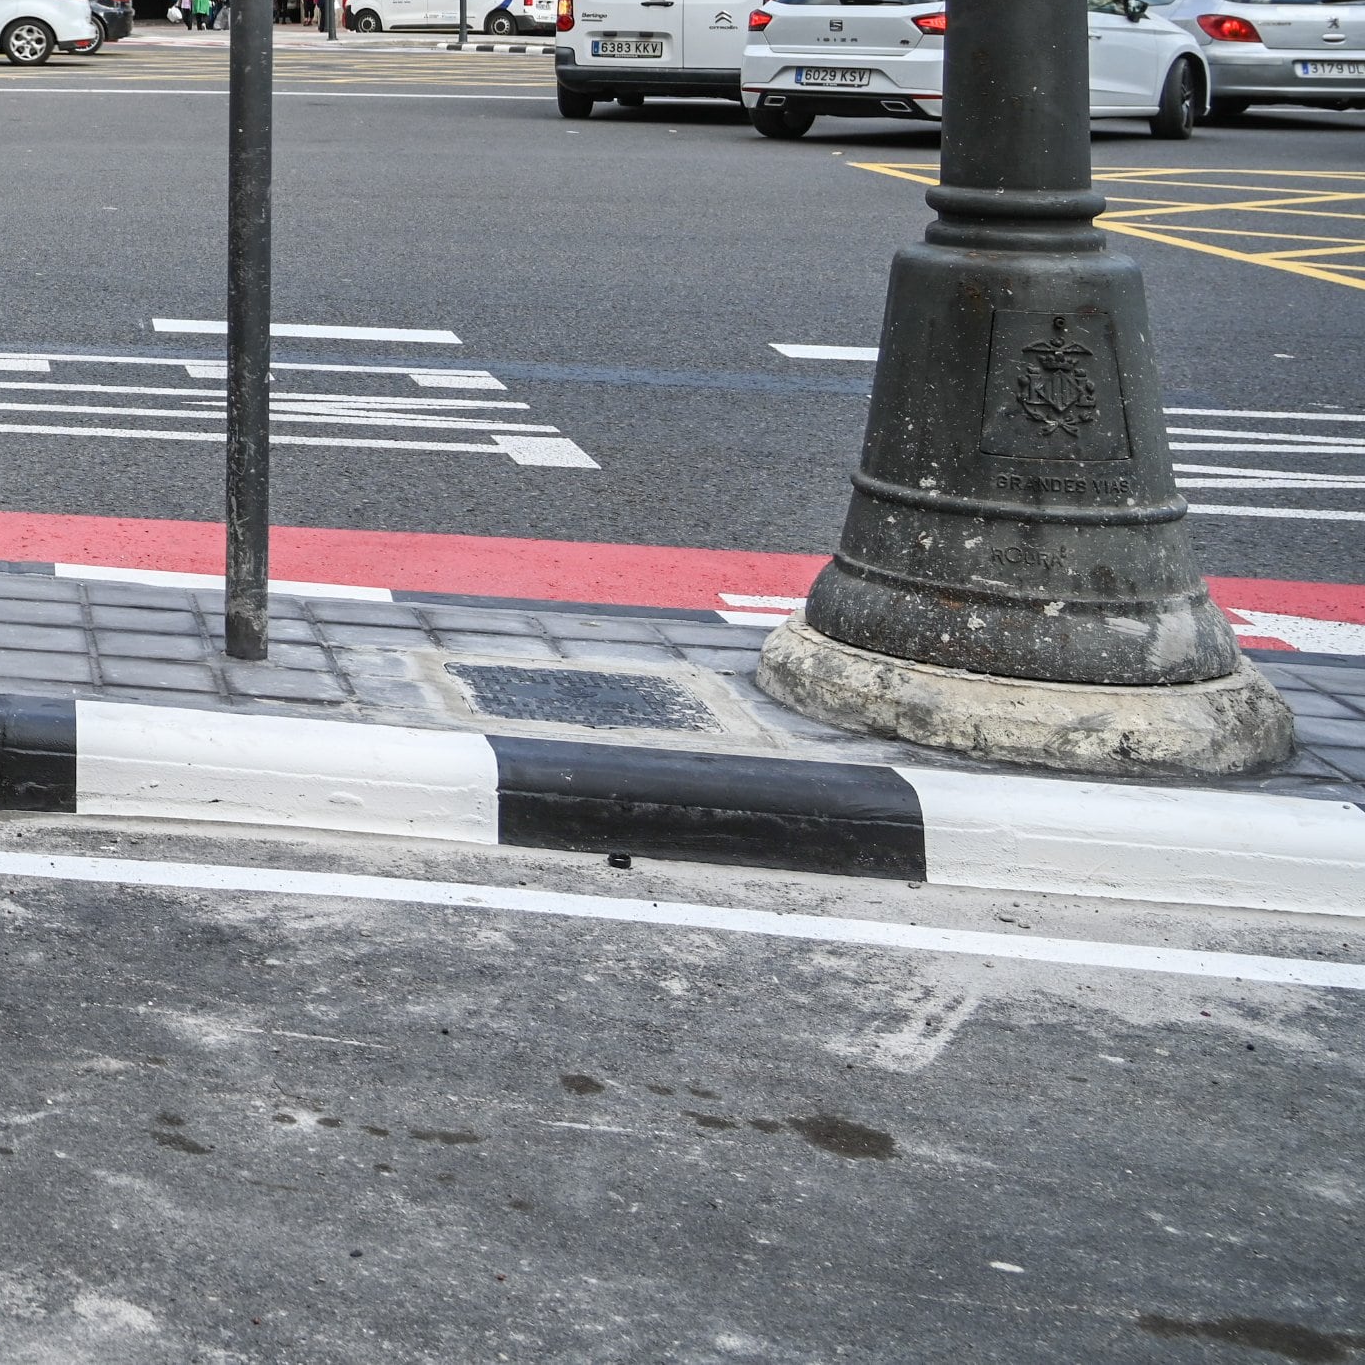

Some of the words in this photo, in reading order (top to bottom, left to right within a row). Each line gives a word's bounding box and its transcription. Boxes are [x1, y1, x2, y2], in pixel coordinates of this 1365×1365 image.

[601, 42, 631, 53] 6383
[635, 43, 659, 54] KKV
[1310, 62, 1344, 74] 3179
[804, 68, 837, 81] 6029
[840, 70, 866, 82] KSV
[995, 474, 1087, 493] GRANDES
[1092, 480, 1131, 495] VIAS
